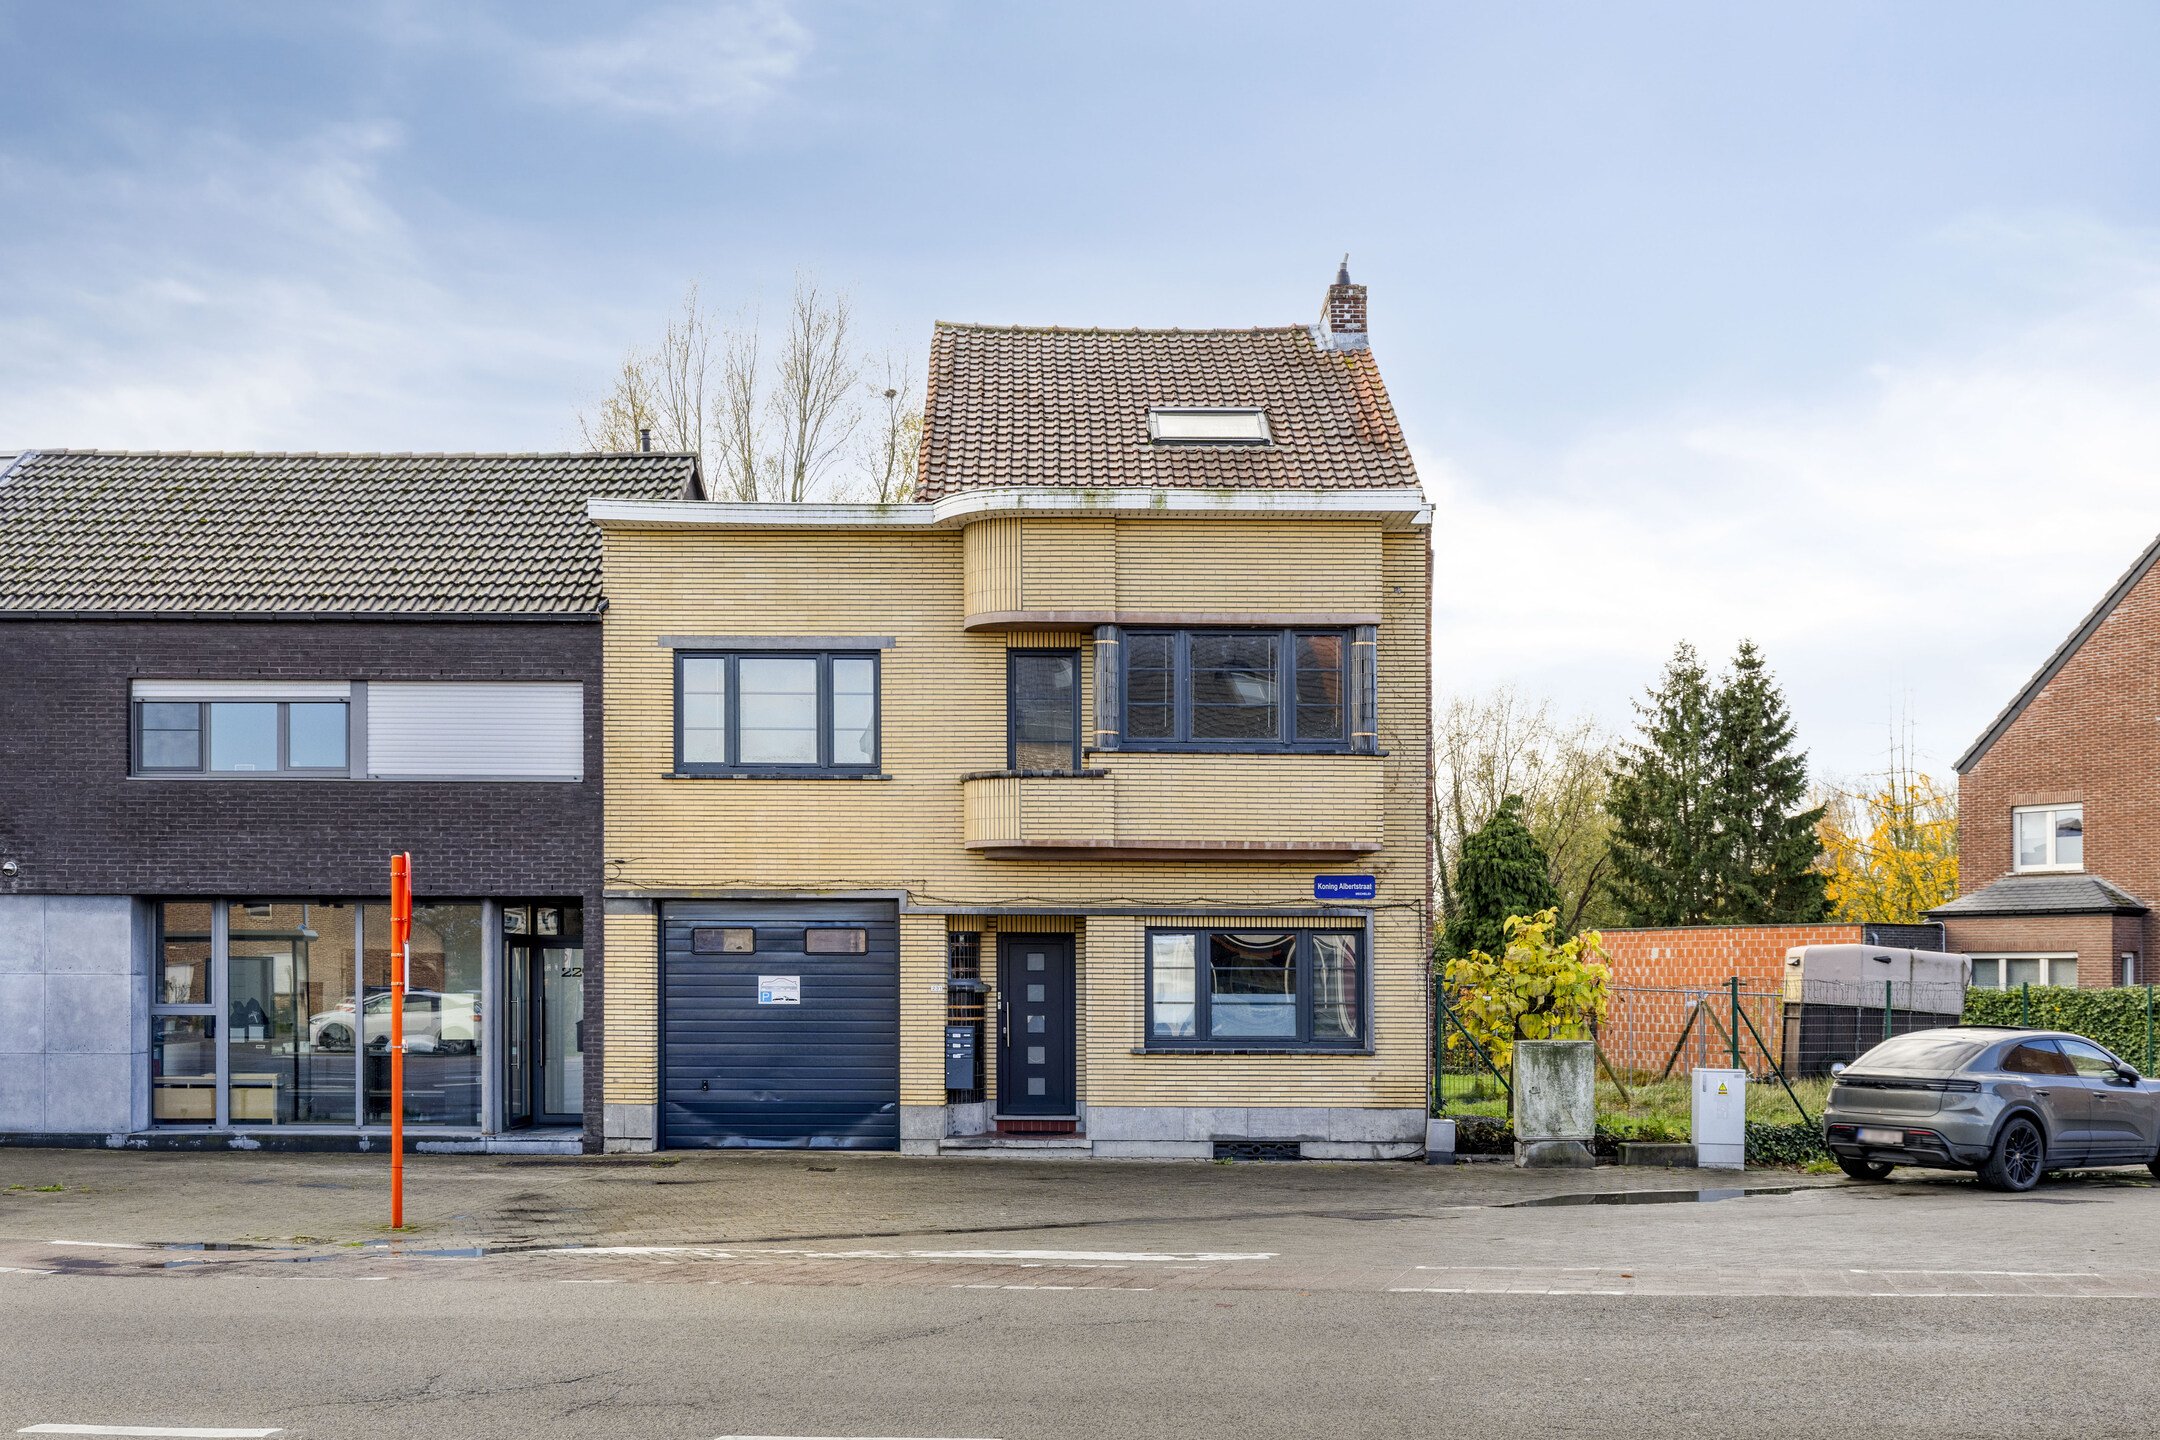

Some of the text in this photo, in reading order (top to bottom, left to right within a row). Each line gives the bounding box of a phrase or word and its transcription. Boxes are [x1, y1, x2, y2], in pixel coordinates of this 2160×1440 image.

[1317, 883, 1338, 891] Koning
[561, 967, 584, 978] 22
[762, 992, 770, 1001] P
